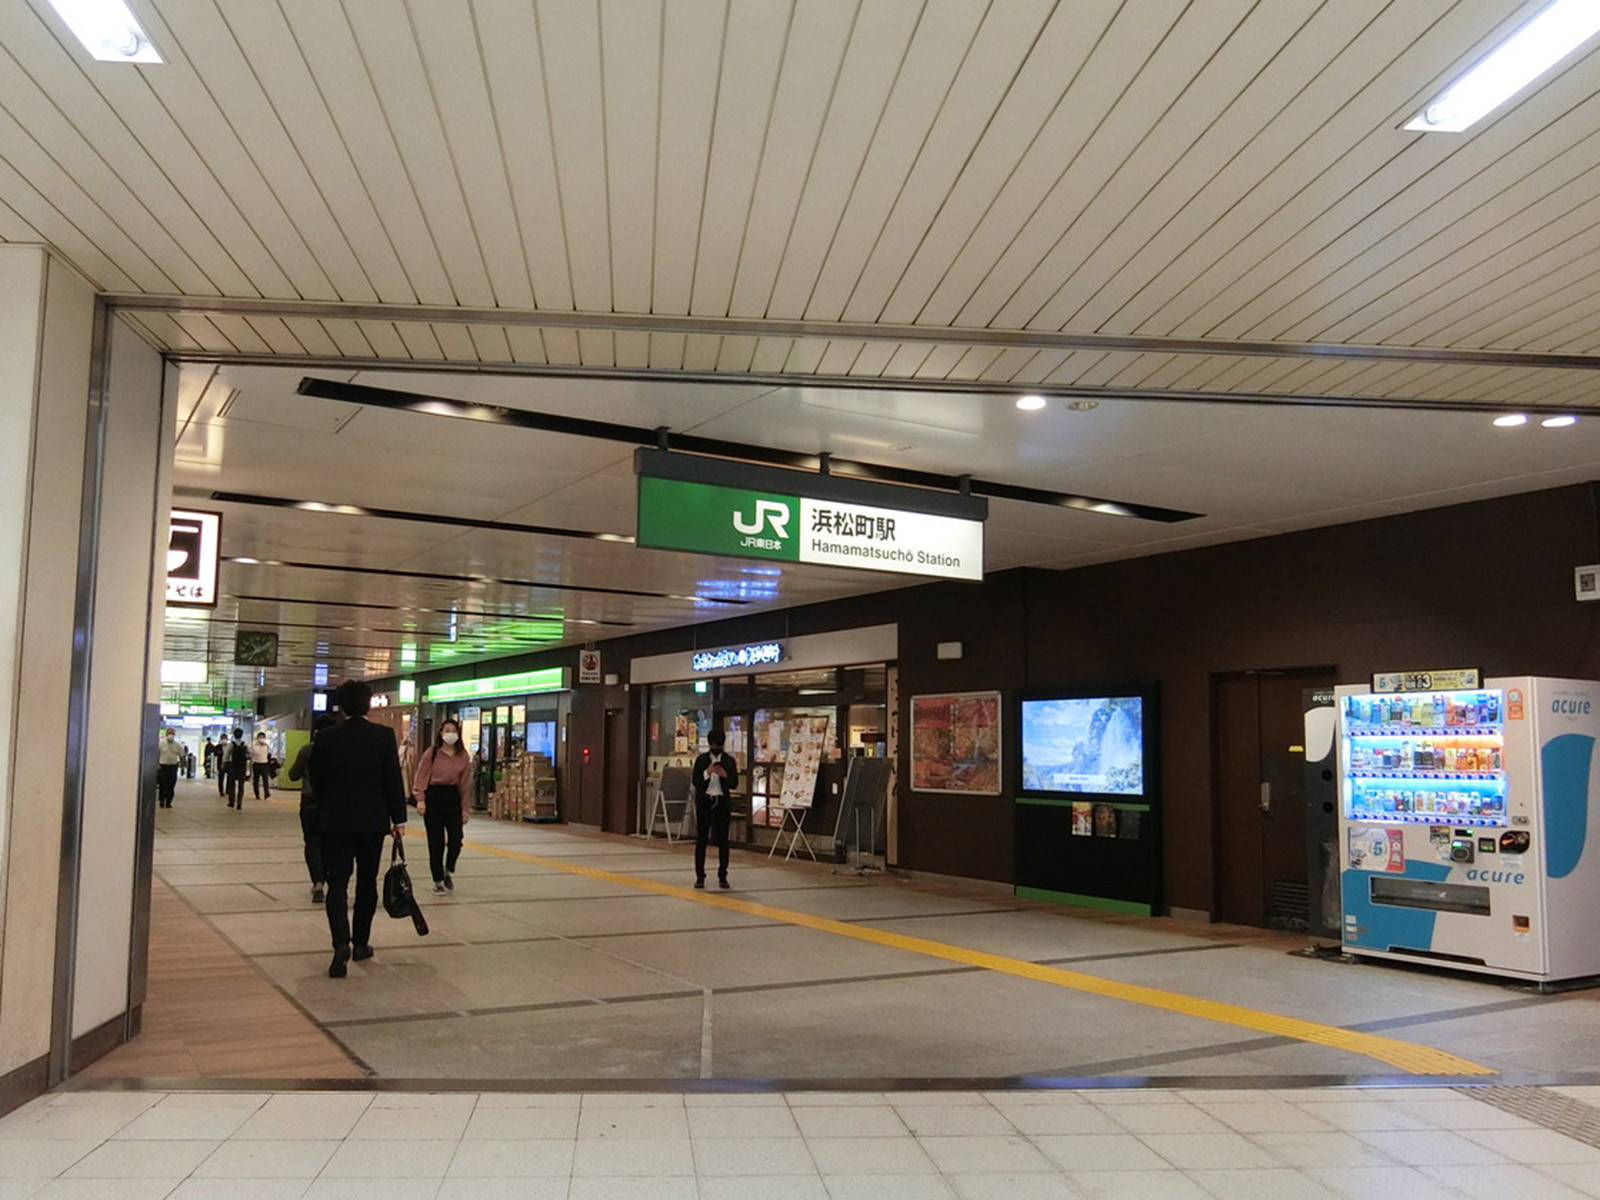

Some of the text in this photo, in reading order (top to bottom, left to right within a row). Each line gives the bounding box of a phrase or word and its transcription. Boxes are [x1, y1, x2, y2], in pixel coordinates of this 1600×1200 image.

[733, 500, 790, 539] JR
[811, 508, 896, 541] 浜松町駅
[740, 536, 782, 551] JR東日本
[917, 550, 961, 568] Station
[1551, 699, 1592, 715] acure
[1466, 869, 1525, 885] acure
